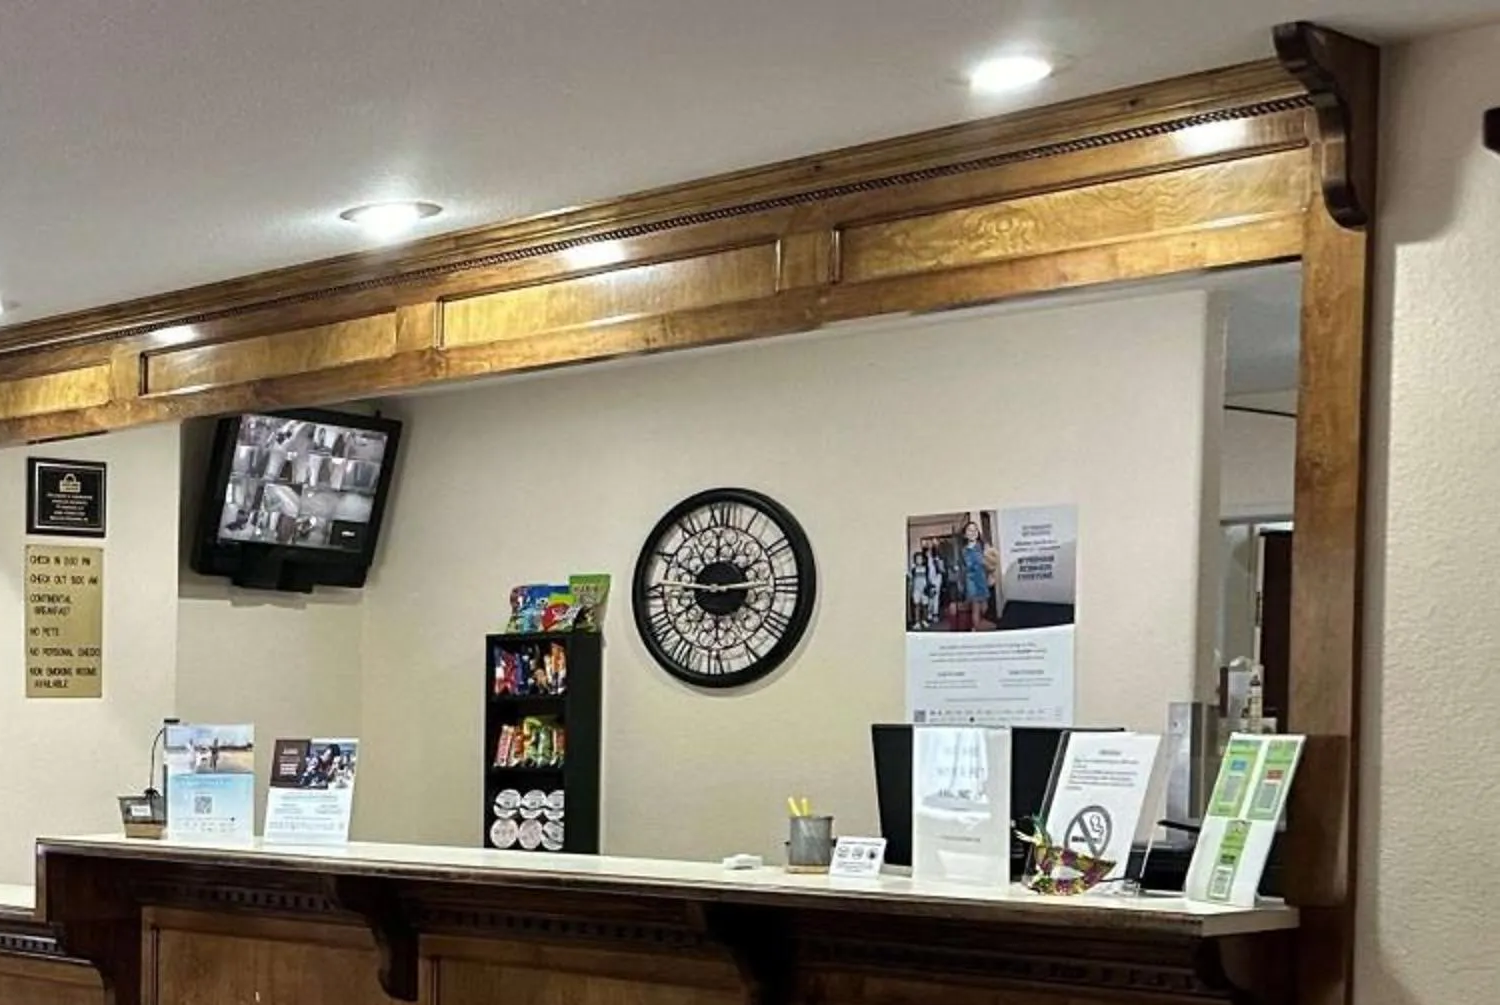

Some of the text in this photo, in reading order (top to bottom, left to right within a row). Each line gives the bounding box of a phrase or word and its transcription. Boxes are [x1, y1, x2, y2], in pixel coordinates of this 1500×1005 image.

[29, 575, 50, 584] CHECK
[54, 575, 67, 585] OUT
[29, 627, 60, 637] NO PETS
[29, 647, 40, 656] NO
[34, 679, 69, 689] AVAILABLE
